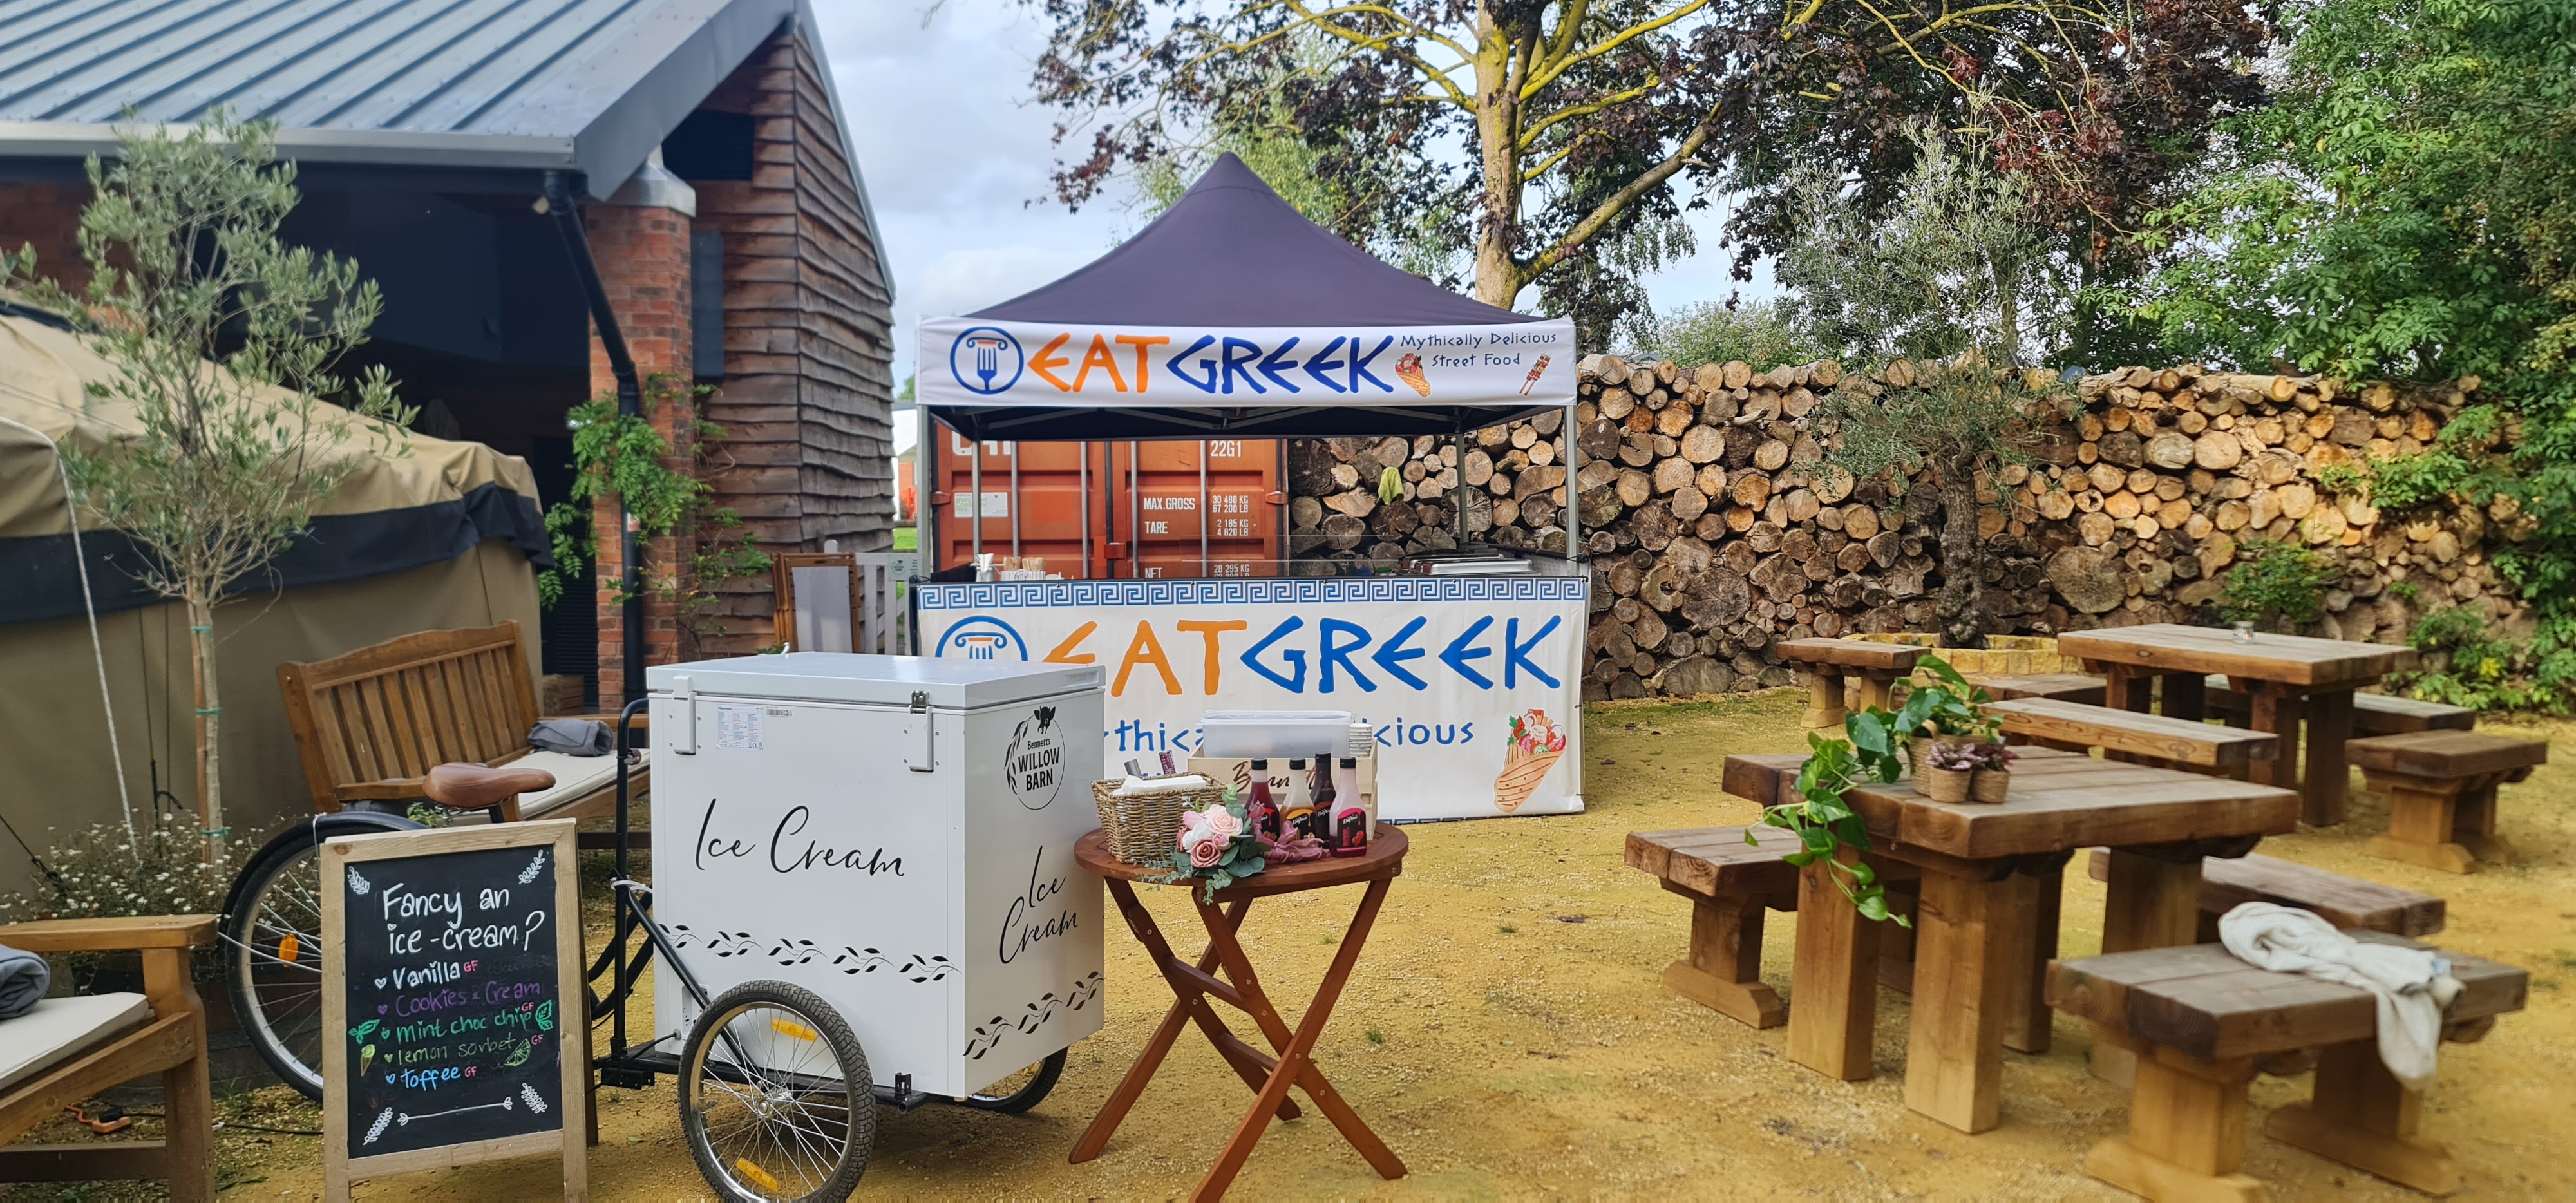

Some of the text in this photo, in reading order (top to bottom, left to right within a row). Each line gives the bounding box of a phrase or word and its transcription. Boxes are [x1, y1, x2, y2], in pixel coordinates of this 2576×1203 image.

[1400, 332, 1557, 350] Mythically Delicious
[1432, 352, 1520, 367] Street Food
[1211, 440, 1242, 457] 22G1
[1212, 495, 1249, 504] 30 480 KG
[1212, 504, 1248, 513] 67 200 LB
[1144, 521, 1168, 534] TARE
[1217, 519, 1249, 527] 2 185 KG
[1213, 564, 1249, 573] 28 295 KG
[1027, 738, 1051, 750] Bennetts
[1018, 746, 1061, 773] WILLOW
[1025, 768, 1054, 791] BARN
[694, 798, 905, 877] Ice Cream
[1028, 845, 1067, 909] Ice
[383, 882, 510, 929] Fancy an
[999, 896, 1079, 965] Cream
[392, 960, 461, 990] Vanilla
[462, 960, 478, 972] GF
[395, 989, 467, 1018] Cookies
[485, 980, 540, 1004] Cream
[397, 1002, 535, 1044] mint choc chip GF
[398, 1032, 544, 1066] lemon sorbet GF
[400, 1066, 477, 1092] toffee GF
